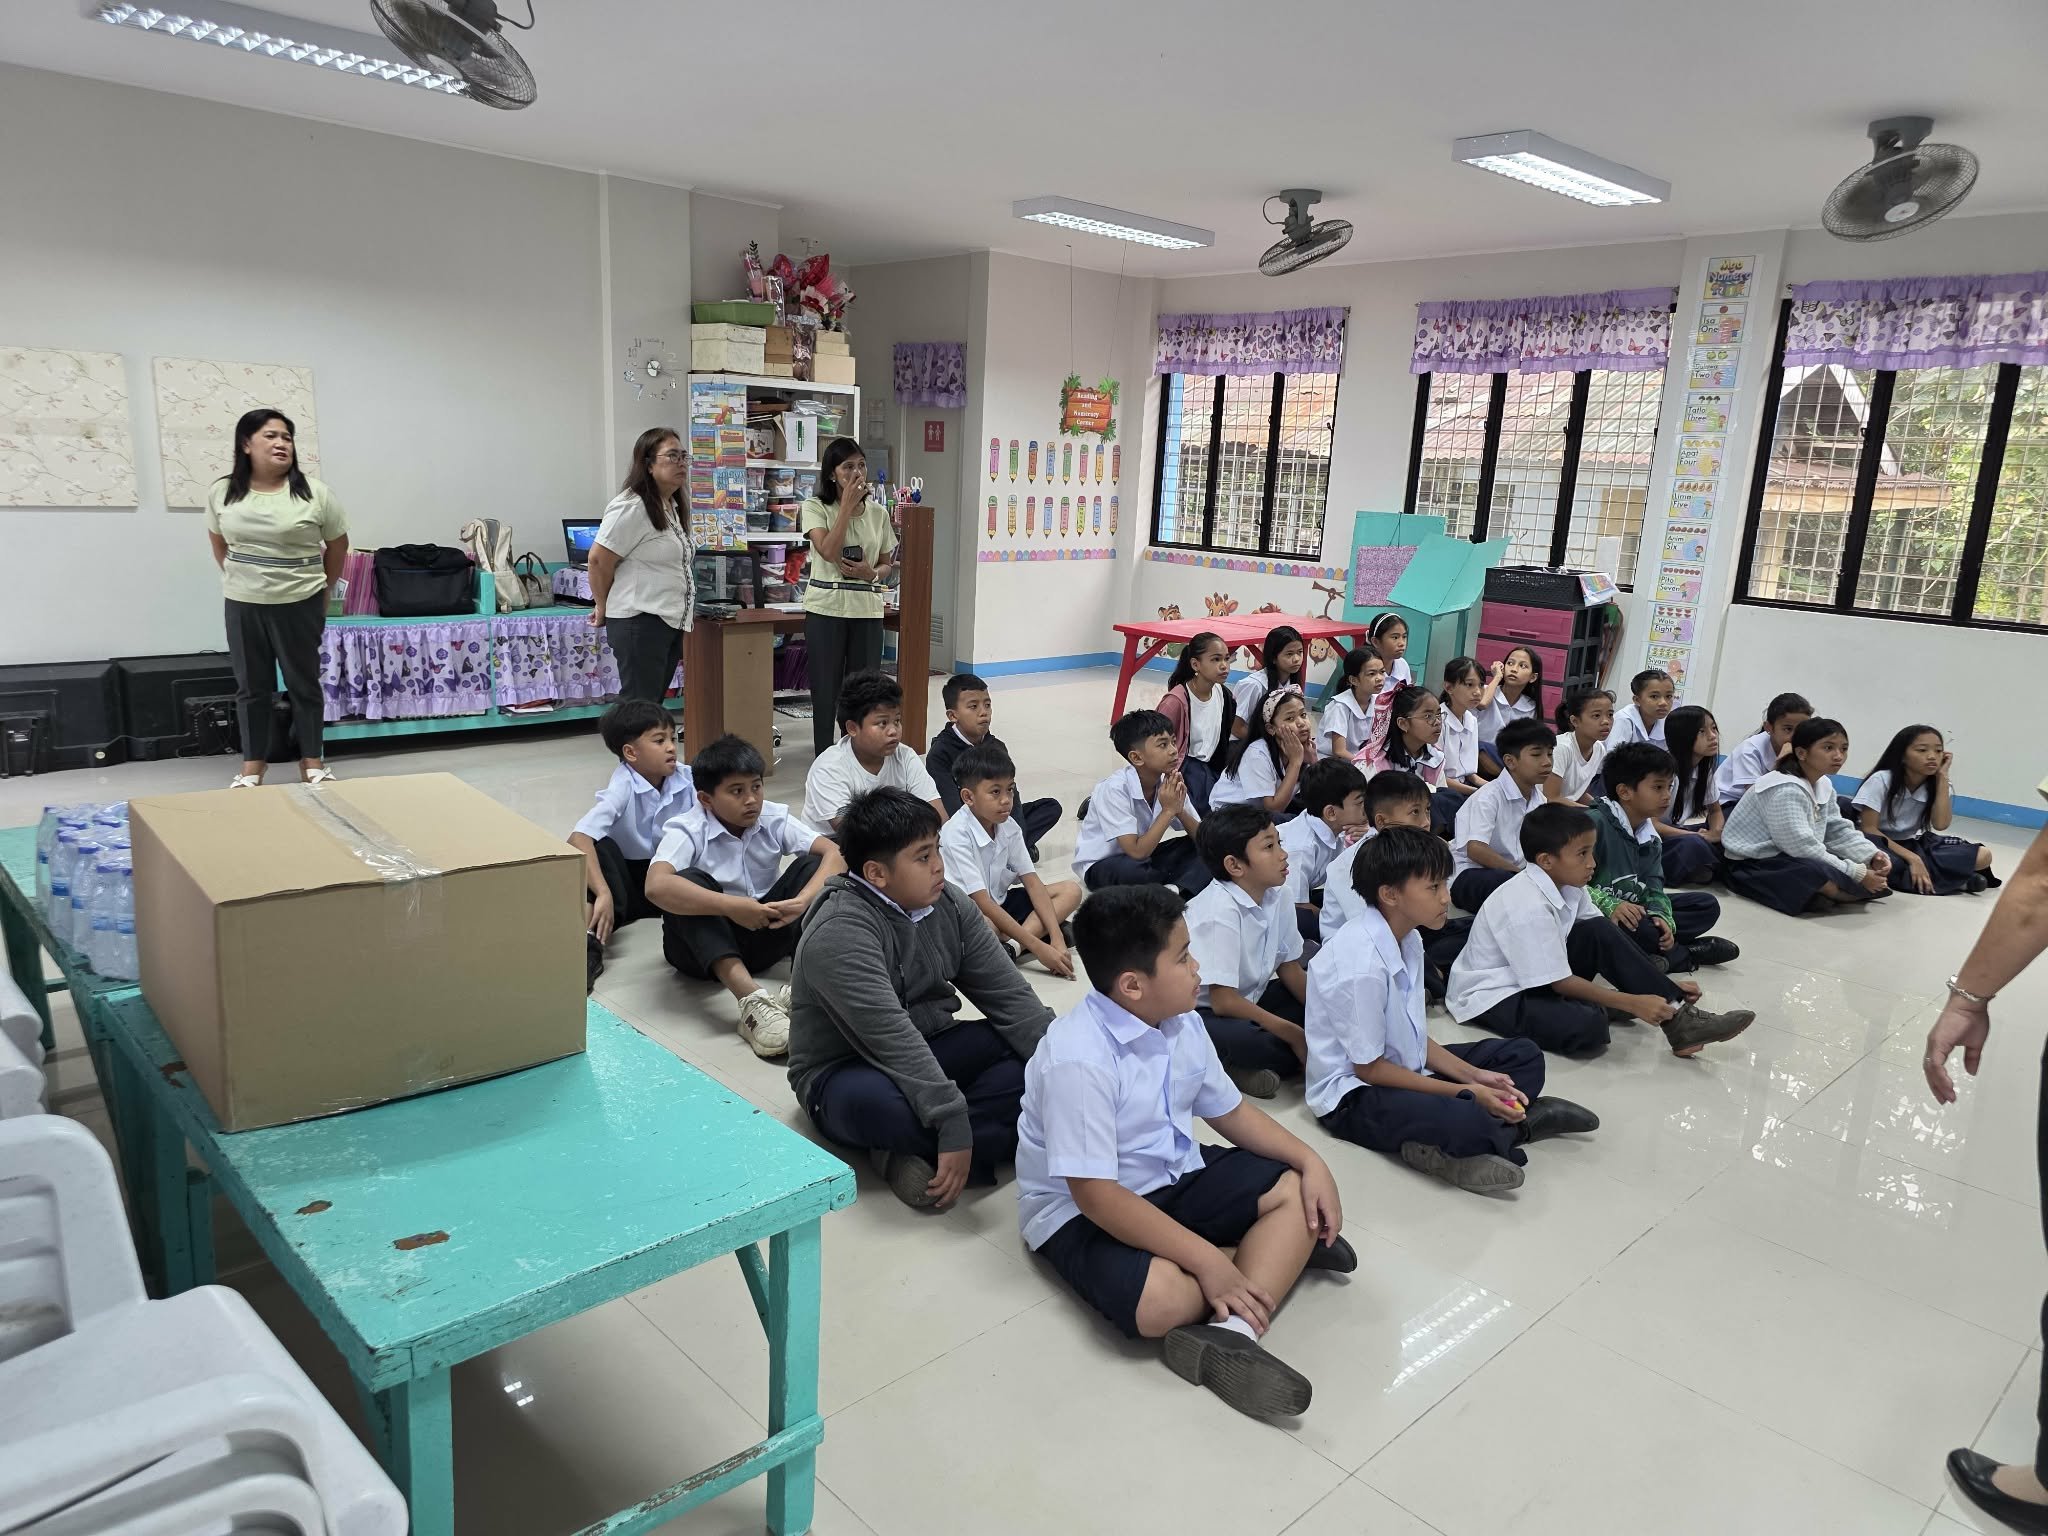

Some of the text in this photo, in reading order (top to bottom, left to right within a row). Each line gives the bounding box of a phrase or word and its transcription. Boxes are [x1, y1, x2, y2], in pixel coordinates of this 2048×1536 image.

[1703, 316, 1716, 324] Isa
[1701, 325, 1719, 333] One
[1688, 406, 1706, 414] Tatlo
[1681, 449, 1699, 458] Apat
[1680, 458, 1697, 466] Four
[1674, 492, 1691, 500] Lima
[1672, 500, 1688, 509] Five
[1661, 575, 1674, 584] Pito
[1660, 584, 1680, 592] Seven
[1657, 617, 1675, 625] Walo
[1654, 624, 1673, 633] Eight
[1648, 657, 1668, 665] Siyam
